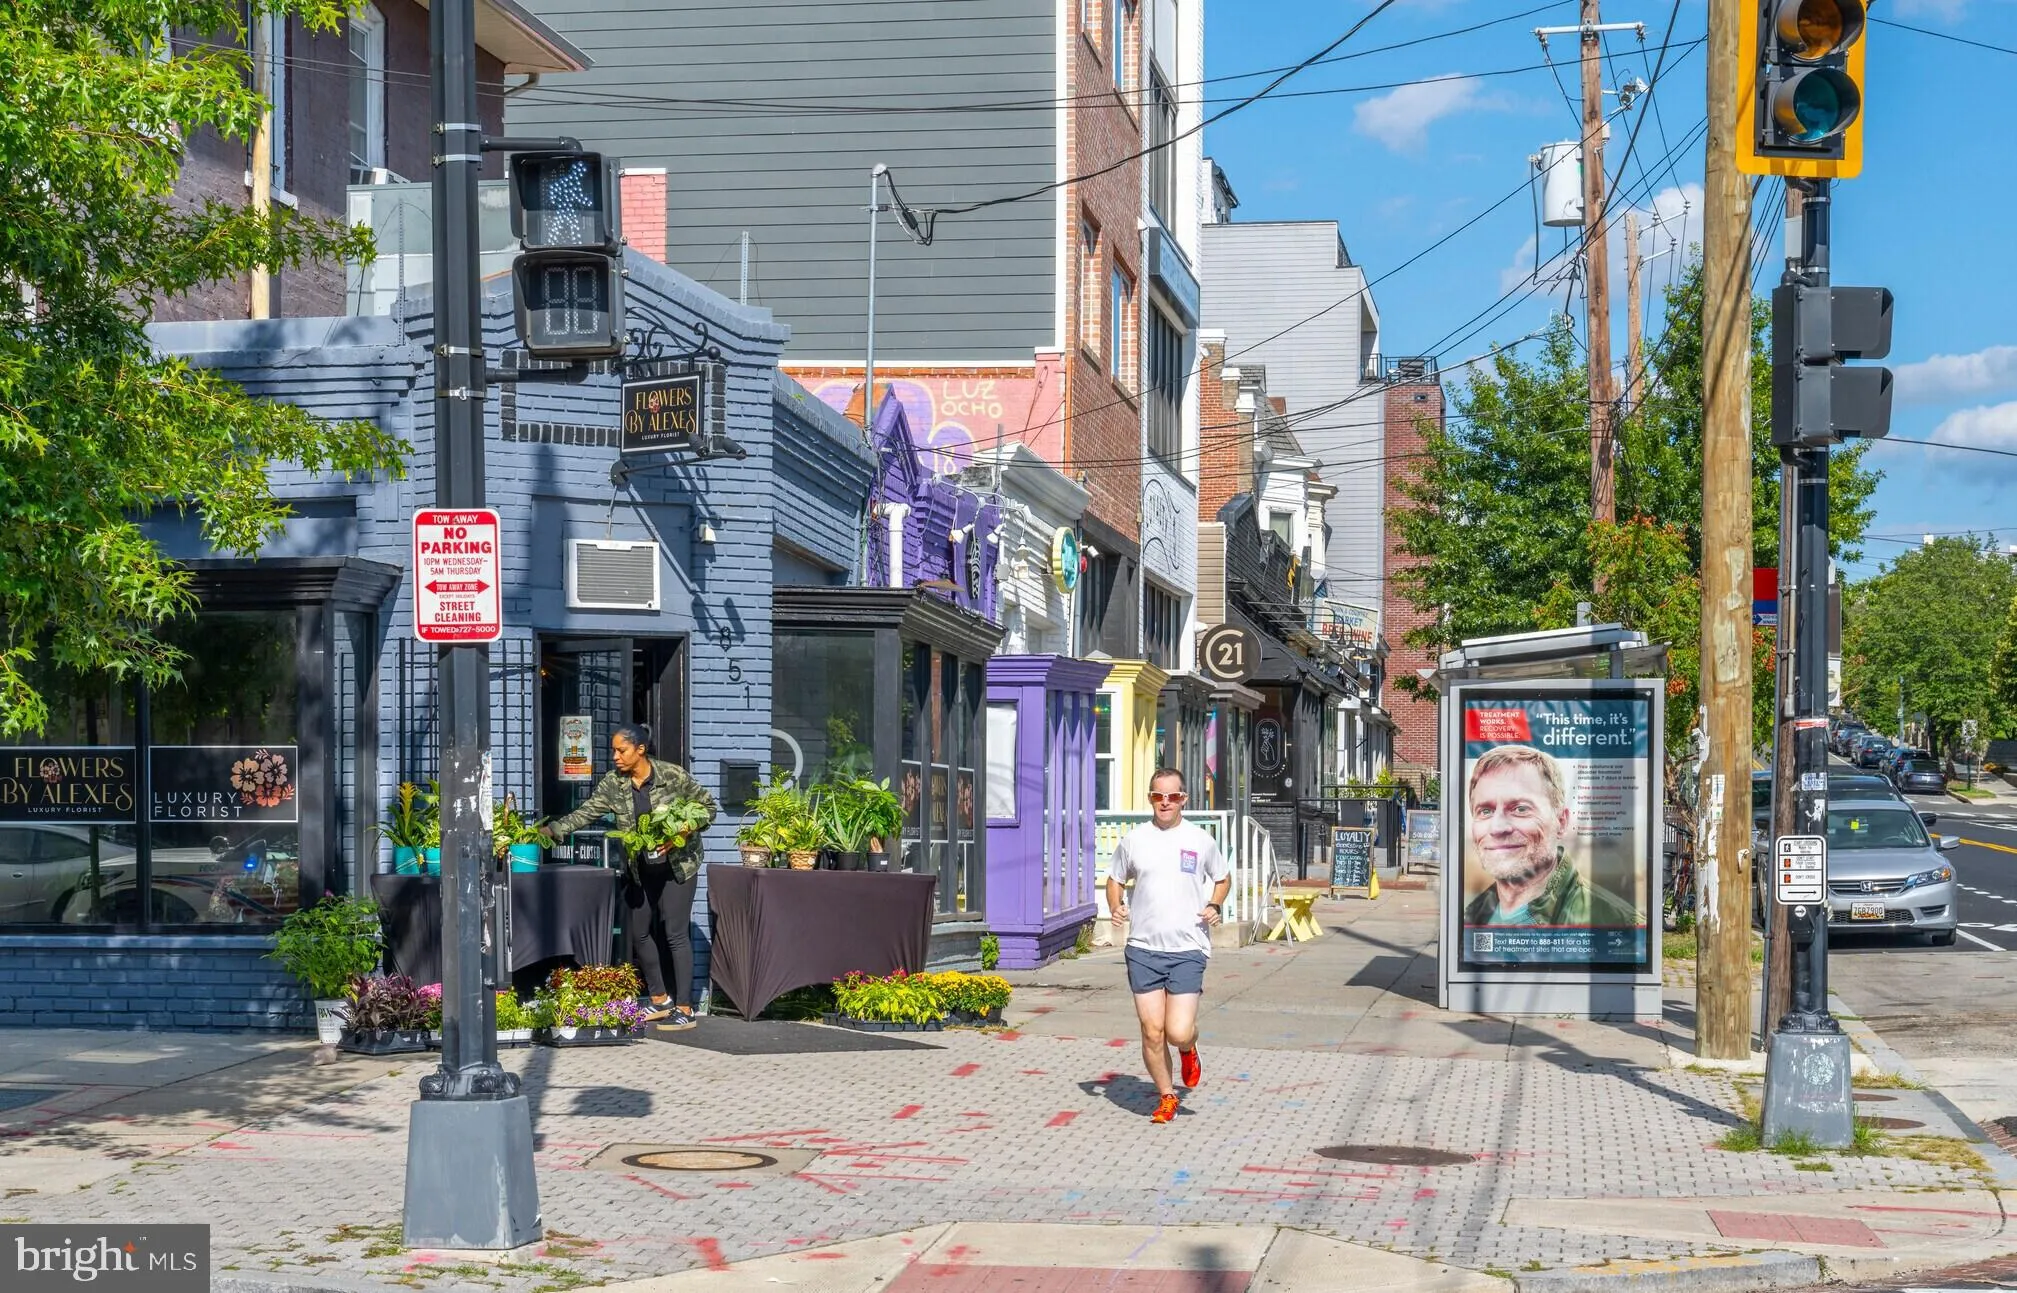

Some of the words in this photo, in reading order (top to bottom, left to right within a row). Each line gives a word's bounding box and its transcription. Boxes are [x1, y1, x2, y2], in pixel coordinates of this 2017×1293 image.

[943, 380, 998, 399] LUZ
[636, 387, 692, 410] FLOWERS
[941, 401, 1003, 418] OCHO
[625, 410, 645, 433] BY
[648, 409, 696, 433] ALEXES
[432, 515, 449, 523] TOW
[453, 515, 478, 523] AWAY
[444, 527, 467, 539] NO
[421, 541, 492, 554] PARKING
[424, 558, 440, 566] 10PM
[430, 567, 444, 575] 5AM
[447, 567, 482, 575] THURSDAY
[440, 601, 475, 611] STREET
[434, 612, 482, 622] CLEANING
[1573, 713, 1606, 726] time,
[15, 757, 125, 779] FLOWERS
[0, 776, 33, 804] BY
[40, 782, 133, 811] ALEXES
[154, 792, 237, 804] LUXURY
[154, 806, 242, 818] FLORIST
[1335, 831, 1371, 842] LOYALTY
[580, 845, 600, 859] CLOSED
